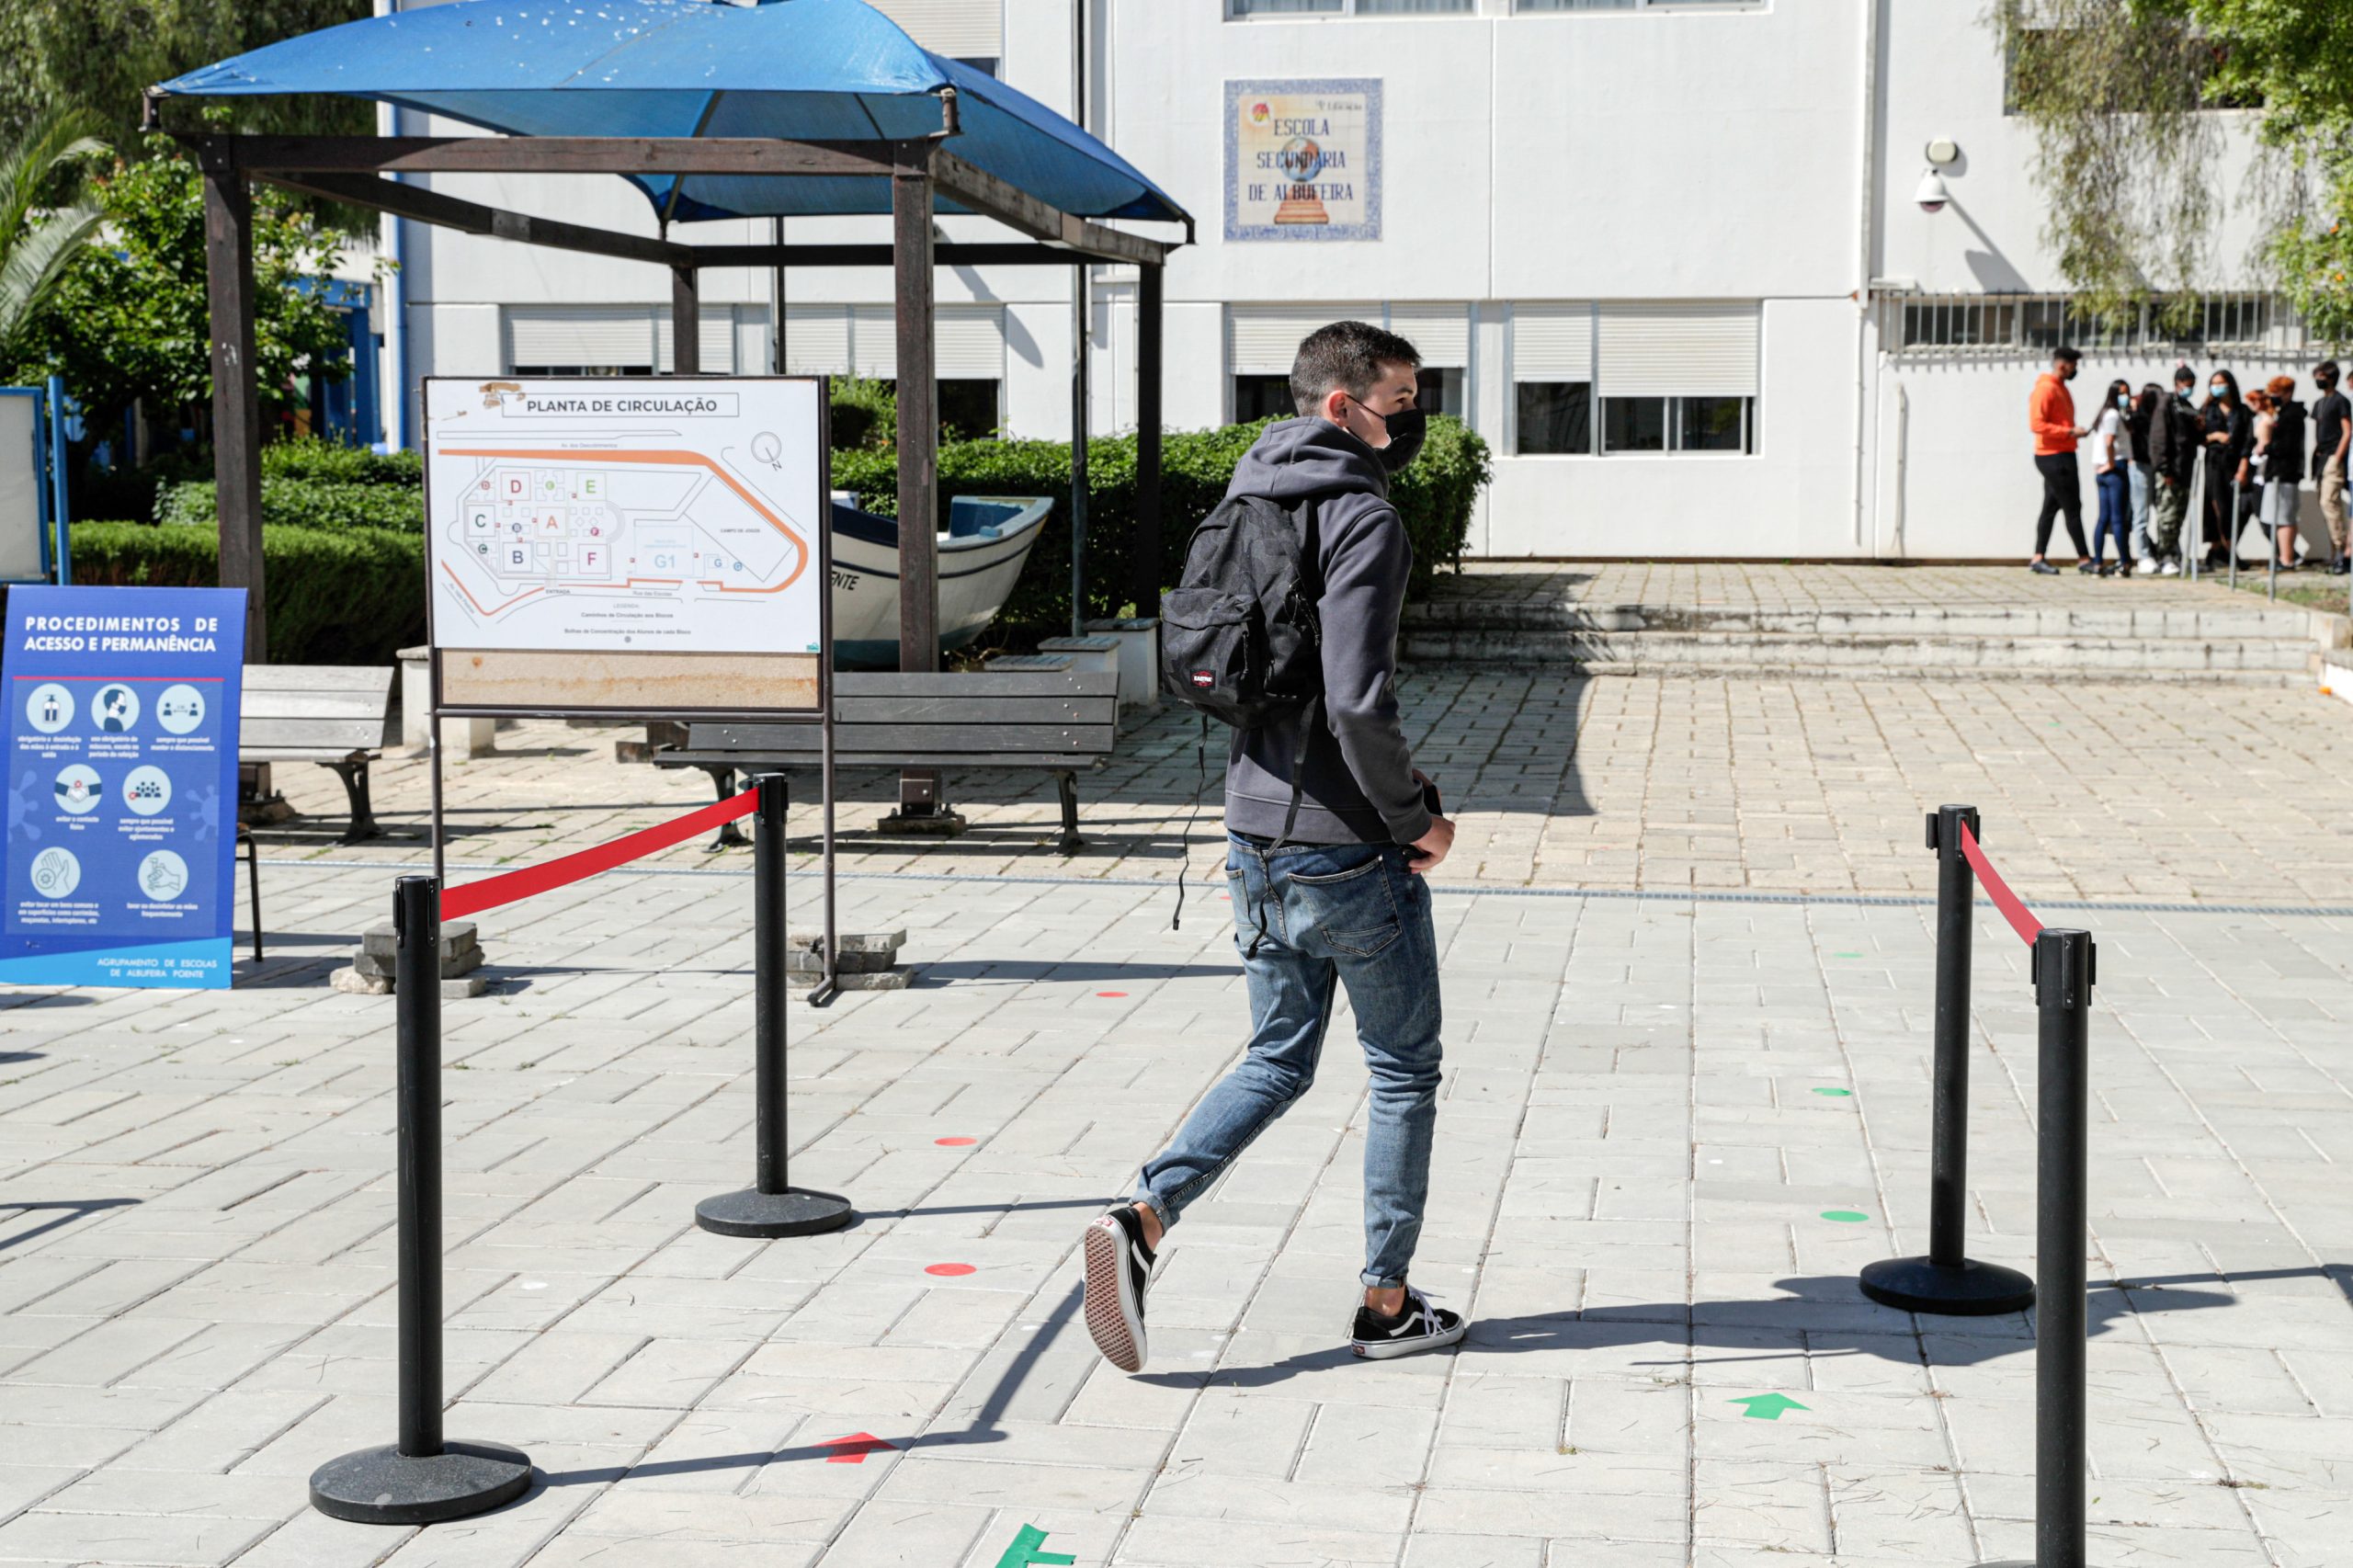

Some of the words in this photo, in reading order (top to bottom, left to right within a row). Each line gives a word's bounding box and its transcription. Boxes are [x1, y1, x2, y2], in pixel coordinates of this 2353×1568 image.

[1274, 119, 1329, 136] ESCOLA
[1249, 184, 1267, 201] DE
[1273, 184, 1354, 201] ALBUFEIRA
[528, 400, 587, 412] PLANTA
[592, 401, 612, 412] DE
[618, 397, 717, 415] CIRCULAÇÃO
[510, 480, 521, 493] D
[585, 480, 597, 494] E
[475, 514, 486, 528] C
[546, 515, 558, 529] A
[513, 551, 524, 563] B
[587, 551, 597, 565] F
[654, 554, 676, 568] G1
[714, 558, 722, 567] G
[25, 617, 180, 631] PROCEDIMENTOS
[195, 618, 218, 631] DE
[24, 636, 85, 651] ACESSO
[88, 637, 97, 651] E
[101, 634, 216, 652] PERMANÊNCIA
[97, 958, 159, 967] AGRUPAMENTO
[164, 959, 175, 968] DE
[180, 960, 218, 969] ESCOLAS
[109, 969, 121, 977] DE
[127, 969, 167, 978] ALBUFEIRA
[173, 970, 204, 978] POENTE
